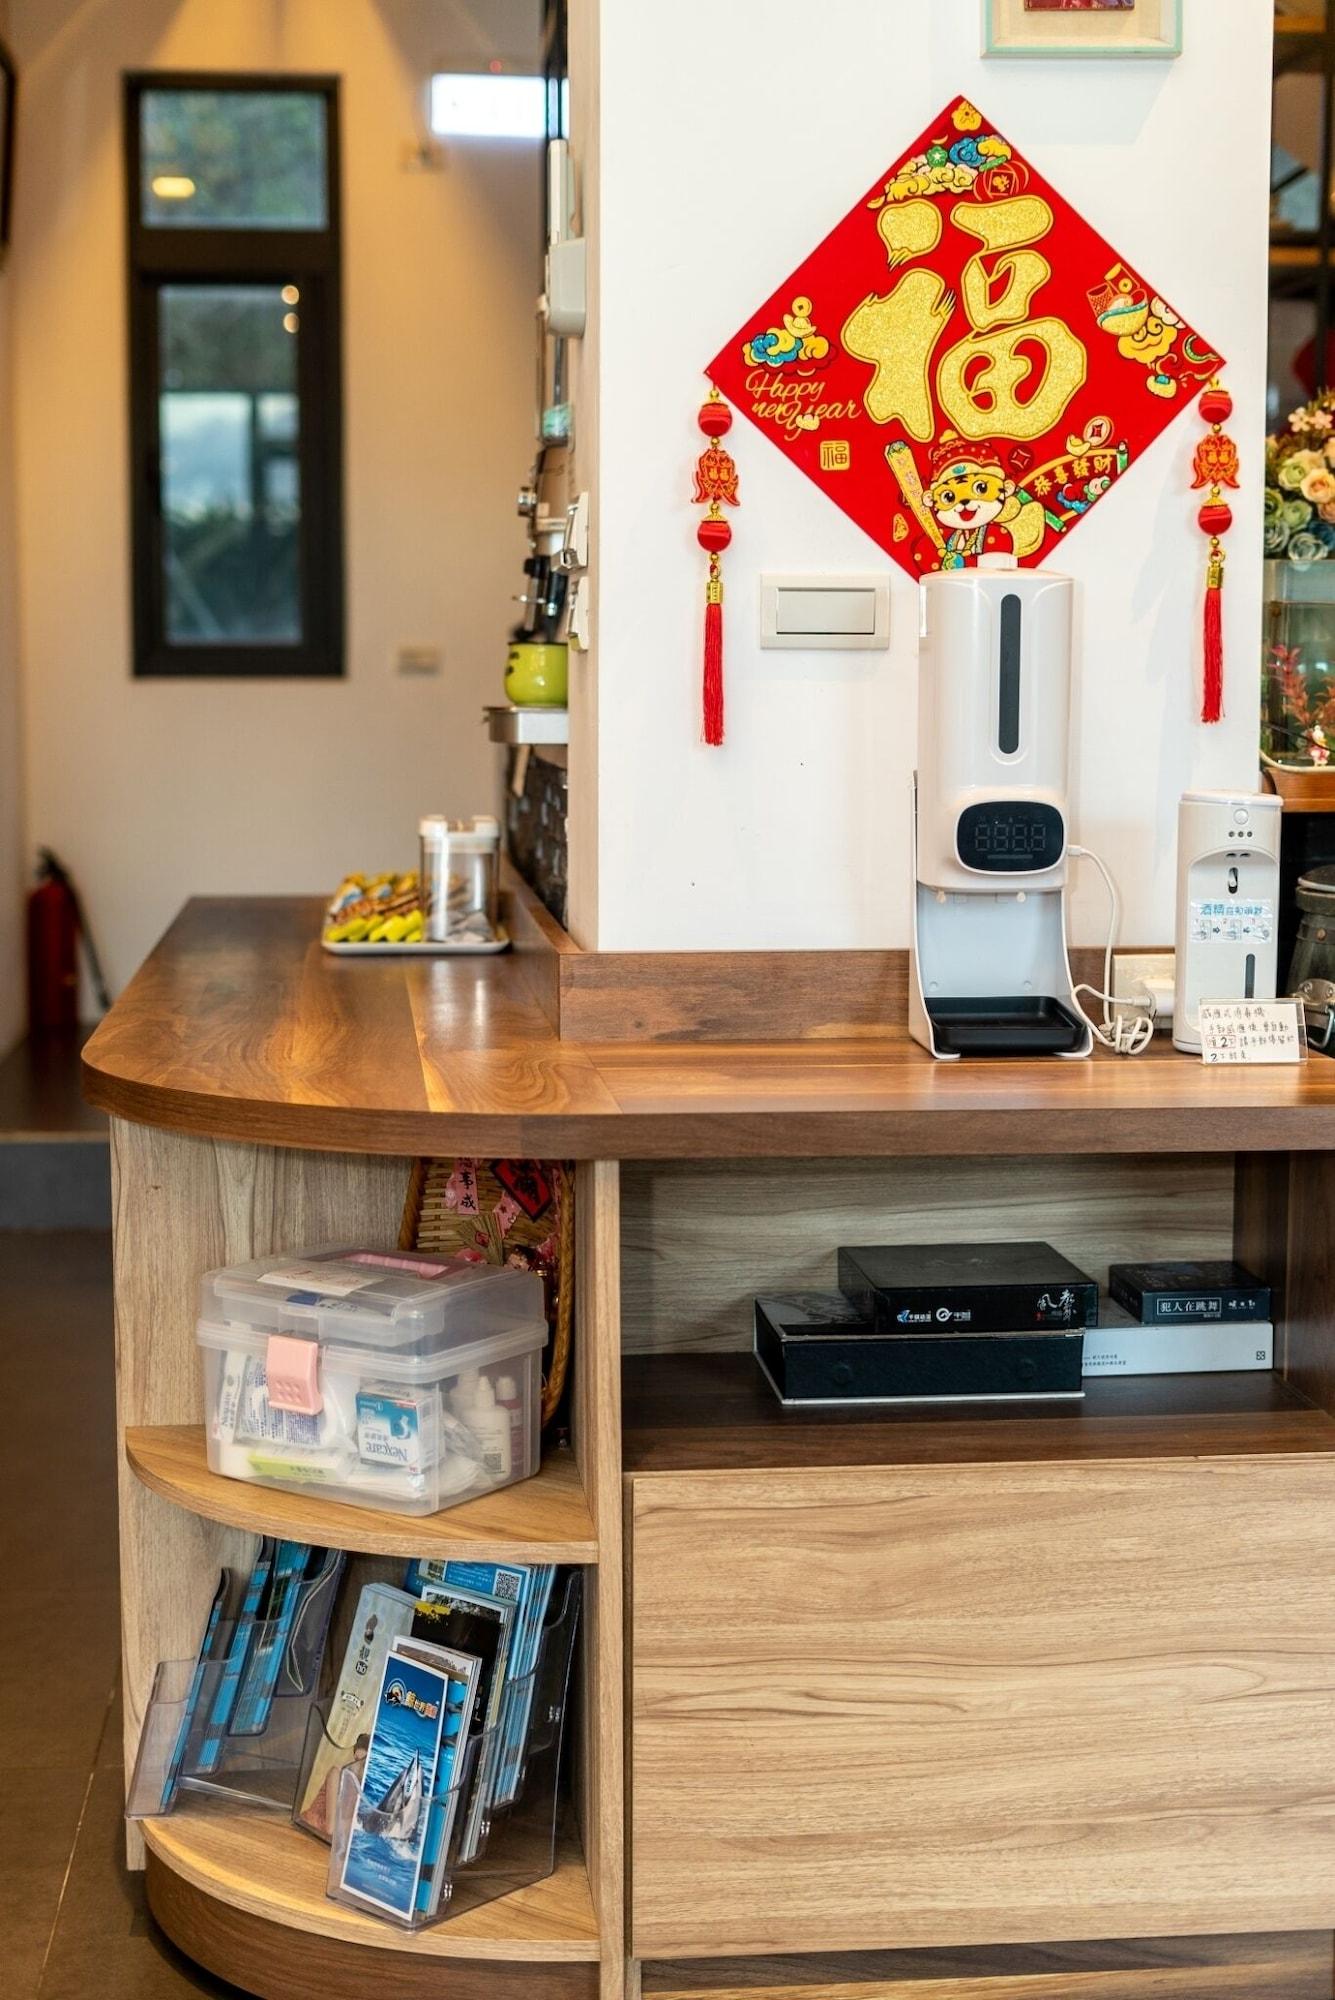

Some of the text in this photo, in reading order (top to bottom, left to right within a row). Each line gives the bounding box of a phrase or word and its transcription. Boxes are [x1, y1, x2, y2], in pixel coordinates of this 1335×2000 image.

[840, 195, 1087, 443] 福
[746, 370, 825, 402] Happy
[822, 442, 848, 468] 福
[1160, 1301, 1218, 1313] 犯人在跳舞
